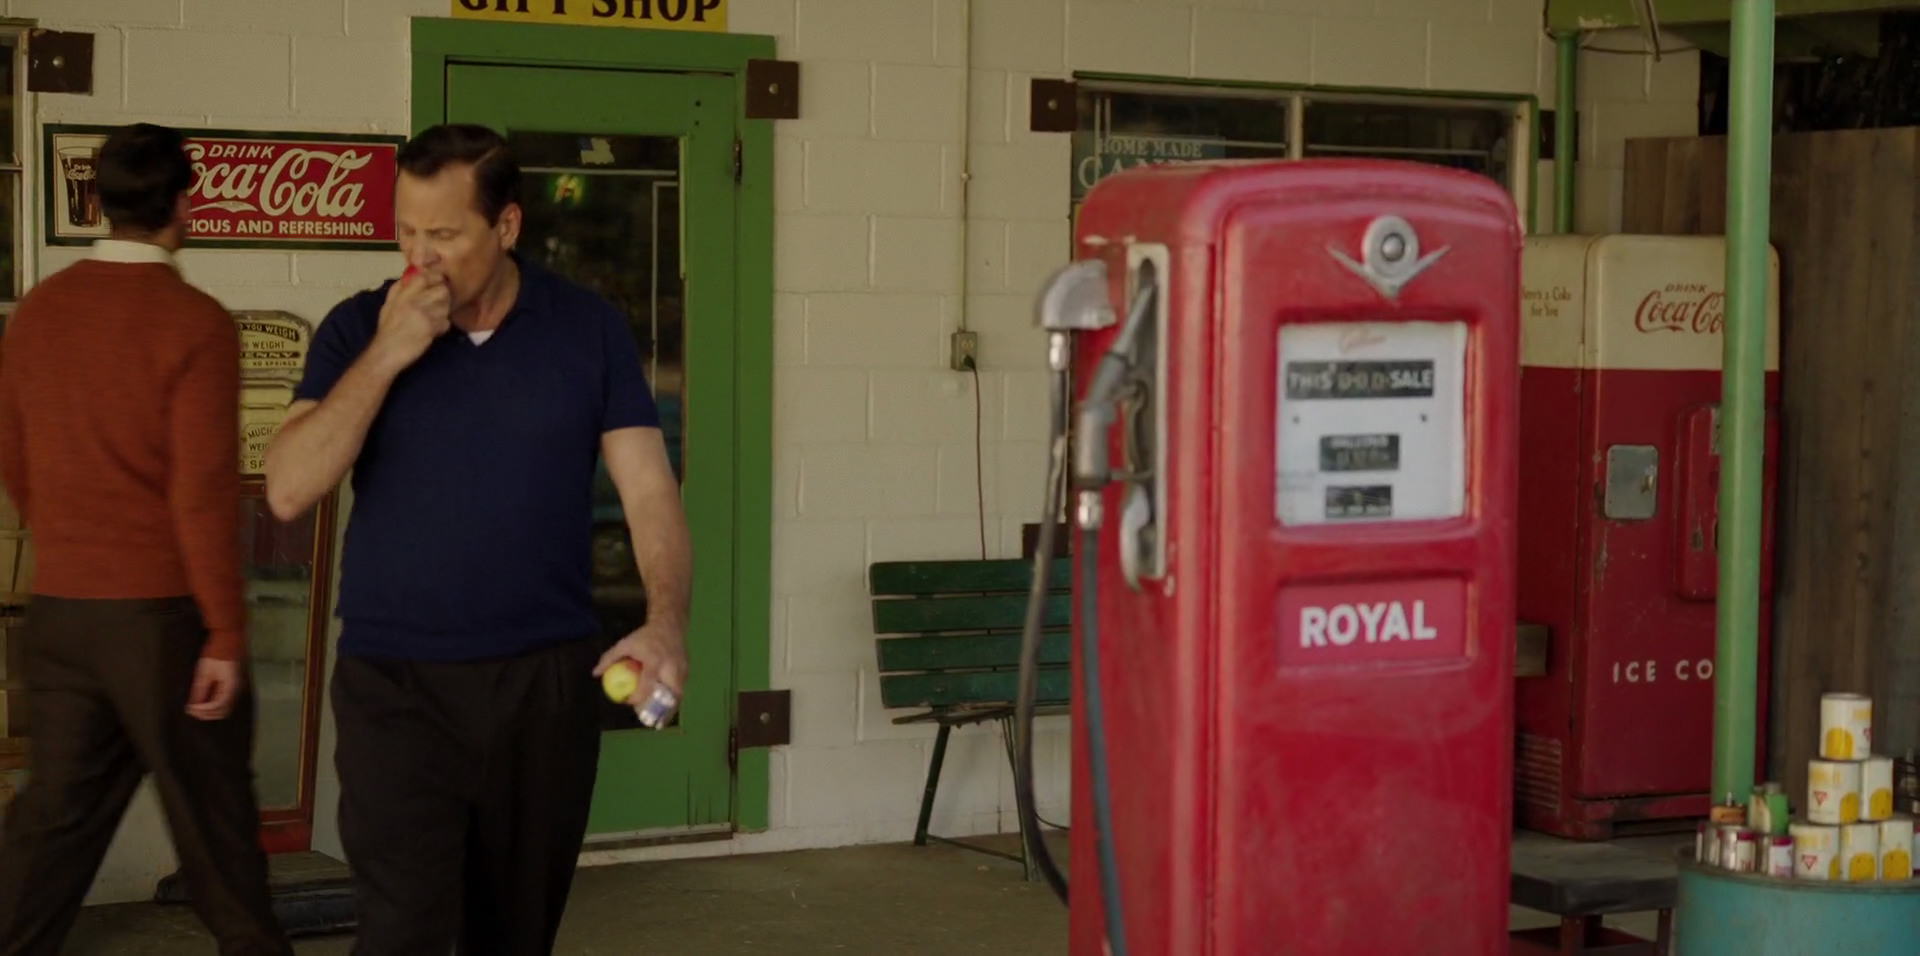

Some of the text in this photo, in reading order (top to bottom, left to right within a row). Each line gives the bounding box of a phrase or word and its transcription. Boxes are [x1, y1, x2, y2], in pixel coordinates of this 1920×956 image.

[208, 144, 276, 159] DRINK
[1098, 138, 1203, 157] HOME MADE
[183, 143, 373, 218] oca-Cola
[236, 220, 274, 234] AND
[278, 220, 375, 236] REFRESHING
[1665, 283, 1708, 293] DRINK
[1634, 290, 1725, 334] Coca-Co
[246, 323, 262, 331] YOU
[265, 325, 296, 341] WEIGH
[252, 340, 285, 350] WEIGHT
[1288, 371, 1332, 390] THIS
[1390, 369, 1433, 389] SALE
[1300, 599, 1438, 648] ROYAL
[1612, 659, 1713, 683] ICE CO
